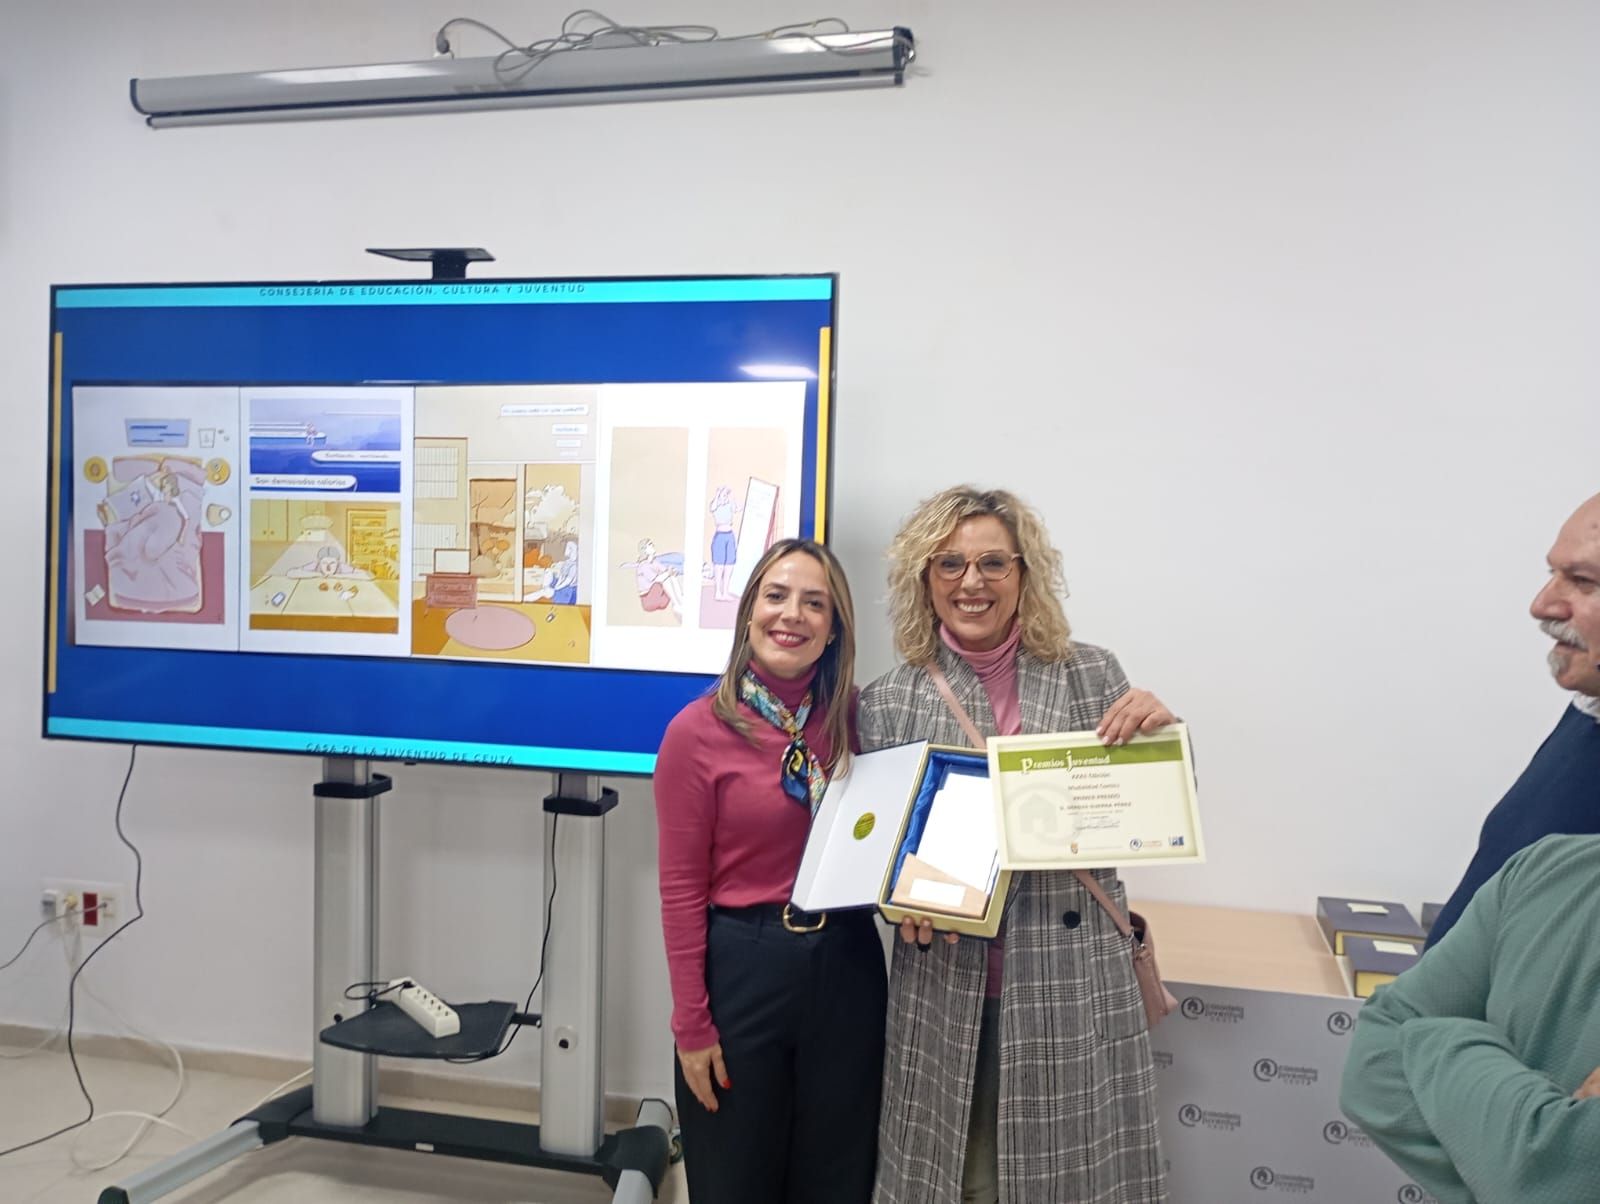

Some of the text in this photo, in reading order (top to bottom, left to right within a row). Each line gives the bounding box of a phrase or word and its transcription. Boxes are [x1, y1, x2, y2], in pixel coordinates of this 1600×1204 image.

[340, 286, 355, 296] DE
[442, 285, 500, 295] CULTURA
[518, 284, 585, 294] JUVENTUD
[306, 742, 514, 765] CASA DE LA JUVENTUD DE CEUTA
[1021, 757, 1065, 774] Premios
